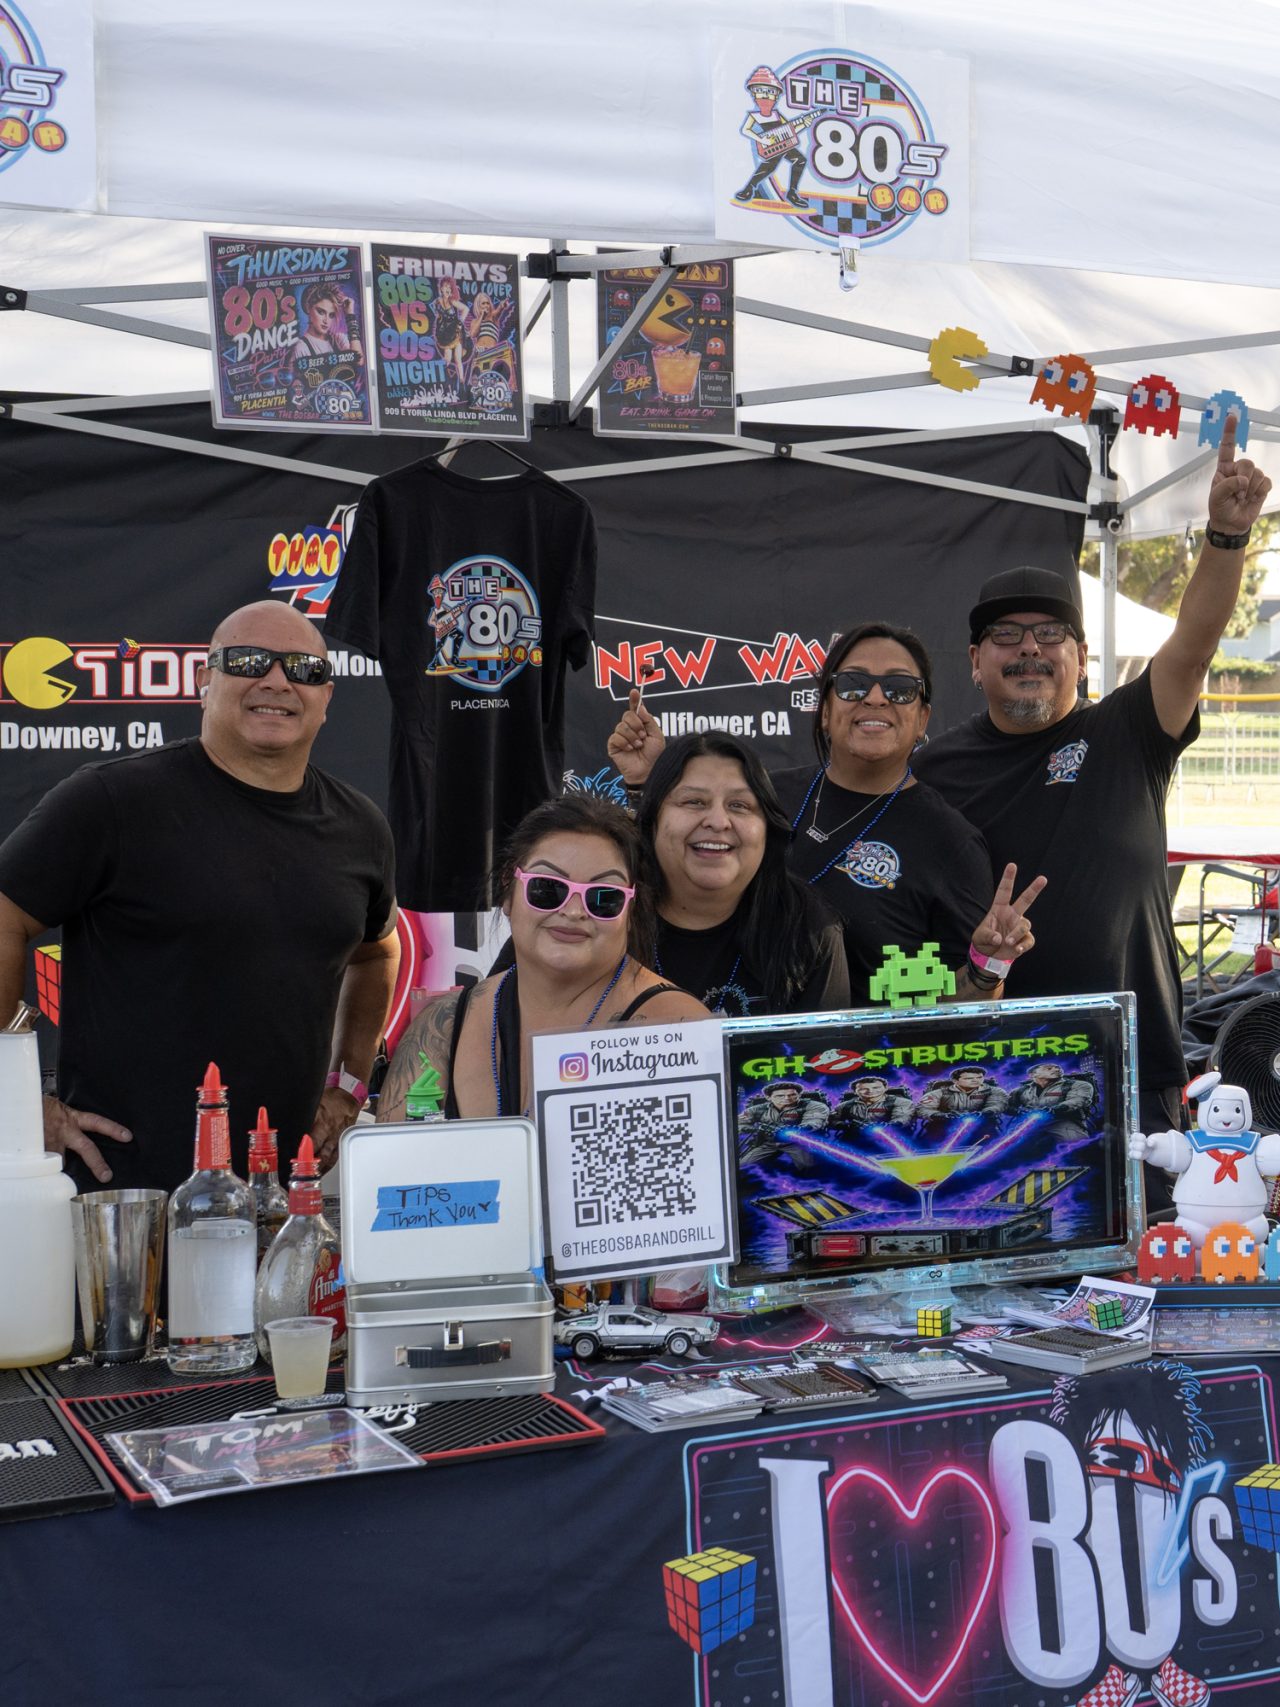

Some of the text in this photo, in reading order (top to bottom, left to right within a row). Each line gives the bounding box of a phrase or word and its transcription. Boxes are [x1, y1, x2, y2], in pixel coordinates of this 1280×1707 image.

[789, 76, 861, 113] THE
[0, 120, 61, 147] AR
[872, 186, 947, 213] BAR
[217, 244, 245, 255] NO COVER
[225, 247, 348, 287] THURSDAYS
[256, 280, 268, 288] GOOD
[269, 279, 283, 287] MUSIC
[337, 273, 351, 281] TIMES
[388, 256, 508, 283] FRIDAYS
[462, 281, 512, 298] NO COVER
[390, 301, 430, 335] VS
[233, 320, 300, 362] DANCE
[298, 353, 355, 369] $3 BEER $3 TACOS
[383, 360, 447, 387] NIGHT
[277, 388, 287, 396] BLVD
[624, 376, 653, 390] BAR
[241, 397, 287, 412] PLACENTIA
[385, 407, 517, 422] 909 E YORBA LINDA BLVD PLACENTIA
[619, 407, 640, 417] EAT.
[674, 407, 700, 417] GAME
[451, 580, 499, 597] THE
[597, 637, 717, 688] NEW
[1, 721, 164, 753] Downey, CA
[652, 711, 791, 738] ellflower, CA
[590, 1033, 683, 1050] FOLLOW US ON
[591, 1050, 699, 1078] Instagram
[446, 1203, 476, 1223] You
[758, 1456, 835, 1707] I
